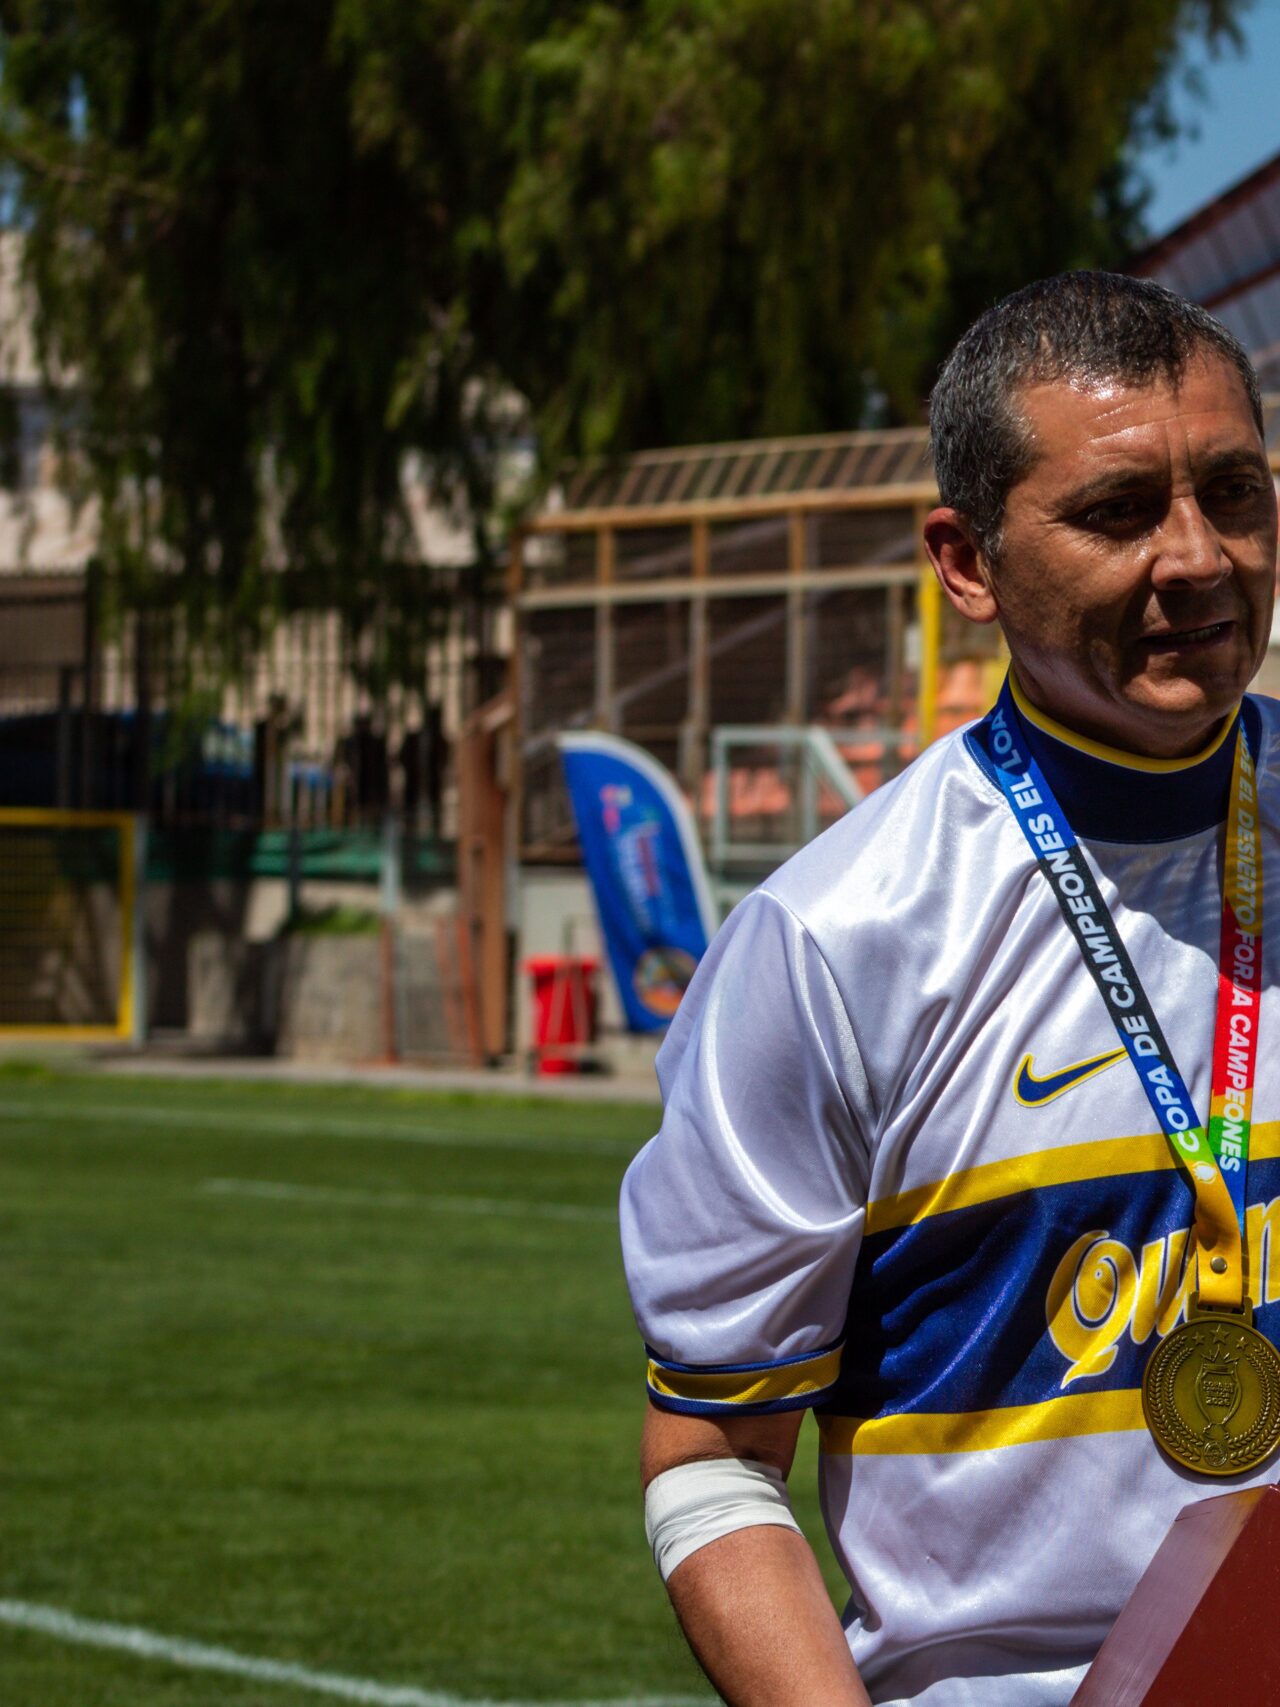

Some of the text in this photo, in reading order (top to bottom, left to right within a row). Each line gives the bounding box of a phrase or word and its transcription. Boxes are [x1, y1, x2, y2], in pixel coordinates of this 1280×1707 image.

[1238, 775, 1253, 804] EL
[1234, 807, 1256, 930] DESIERTO
[991, 708, 1201, 1153] COPA DE CAMPEONES EL LOA
[1231, 928, 1256, 1008] FORJA
[1219, 1014, 1252, 1173] CAMPEONES
